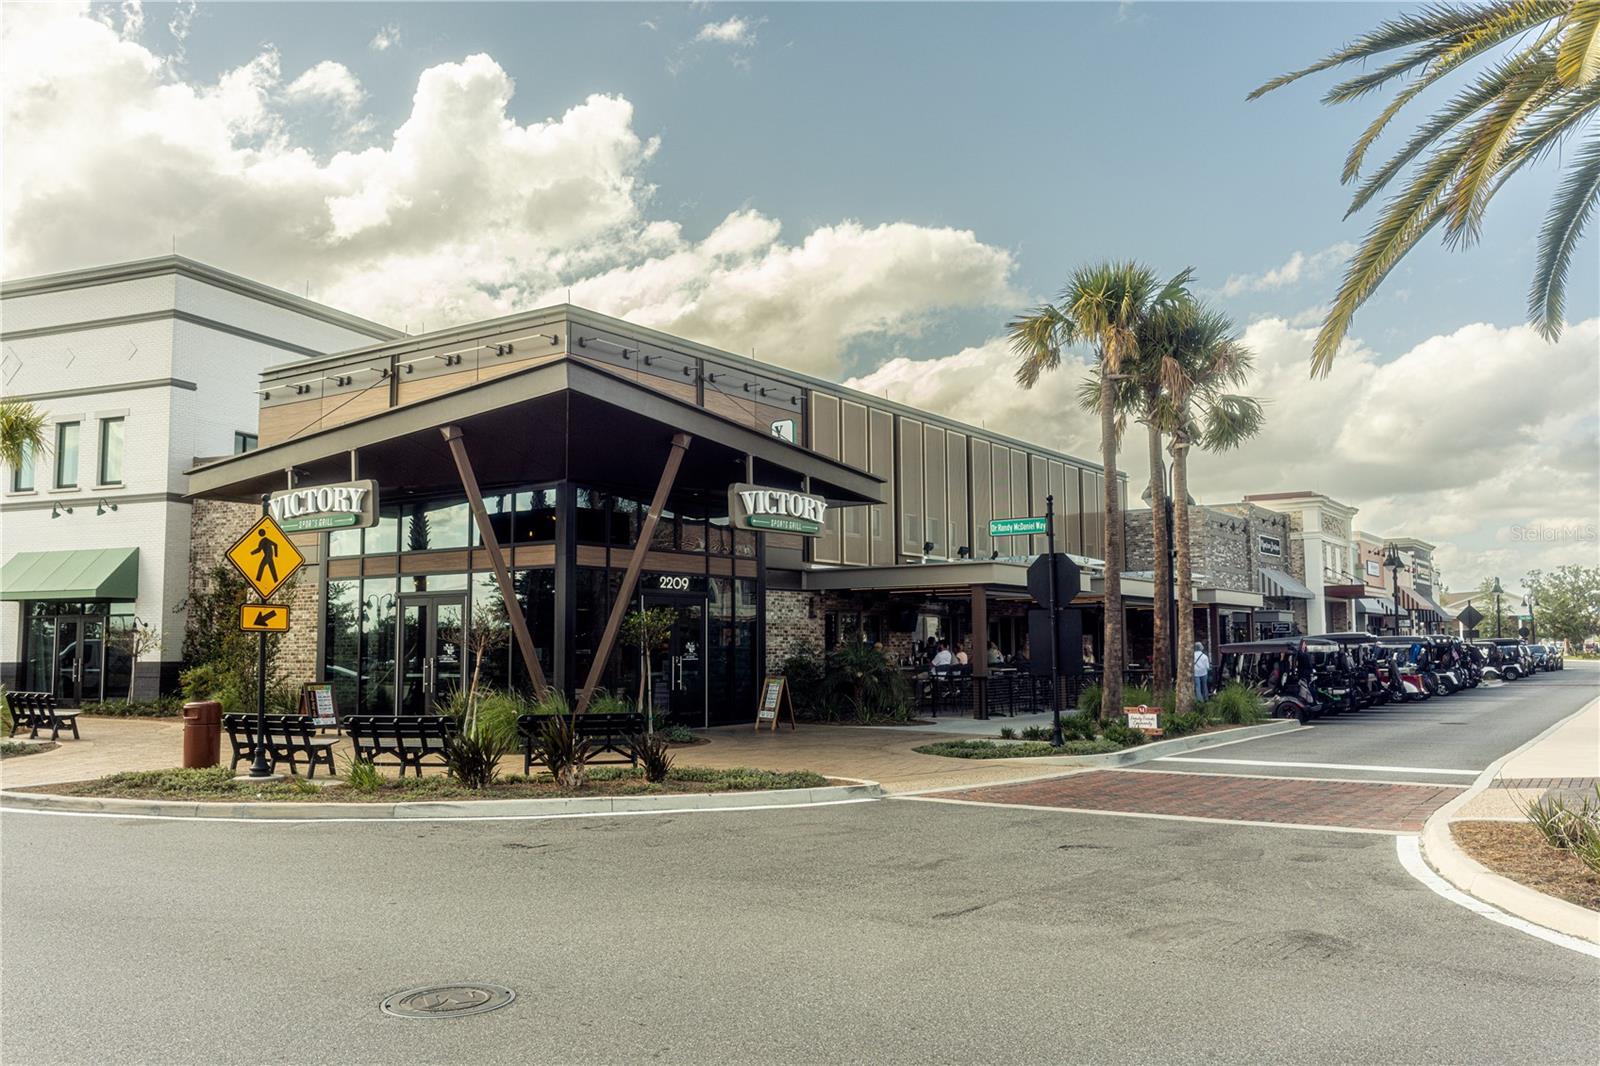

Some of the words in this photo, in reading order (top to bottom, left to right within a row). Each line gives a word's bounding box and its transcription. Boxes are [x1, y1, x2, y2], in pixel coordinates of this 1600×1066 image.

[268, 487, 368, 520] VICTORY
[739, 490, 828, 524] VICTORY
[298, 519, 318, 529] SPORTS
[319, 517, 333, 527] GRILL
[770, 519, 788, 529] SPORTS
[789, 521, 802, 531] GRILL
[998, 523, 1012, 533] Randy
[1013, 521, 1034, 531] McDaniel
[1035, 521, 1046, 532] Way
[660, 576, 689, 590] 2209
